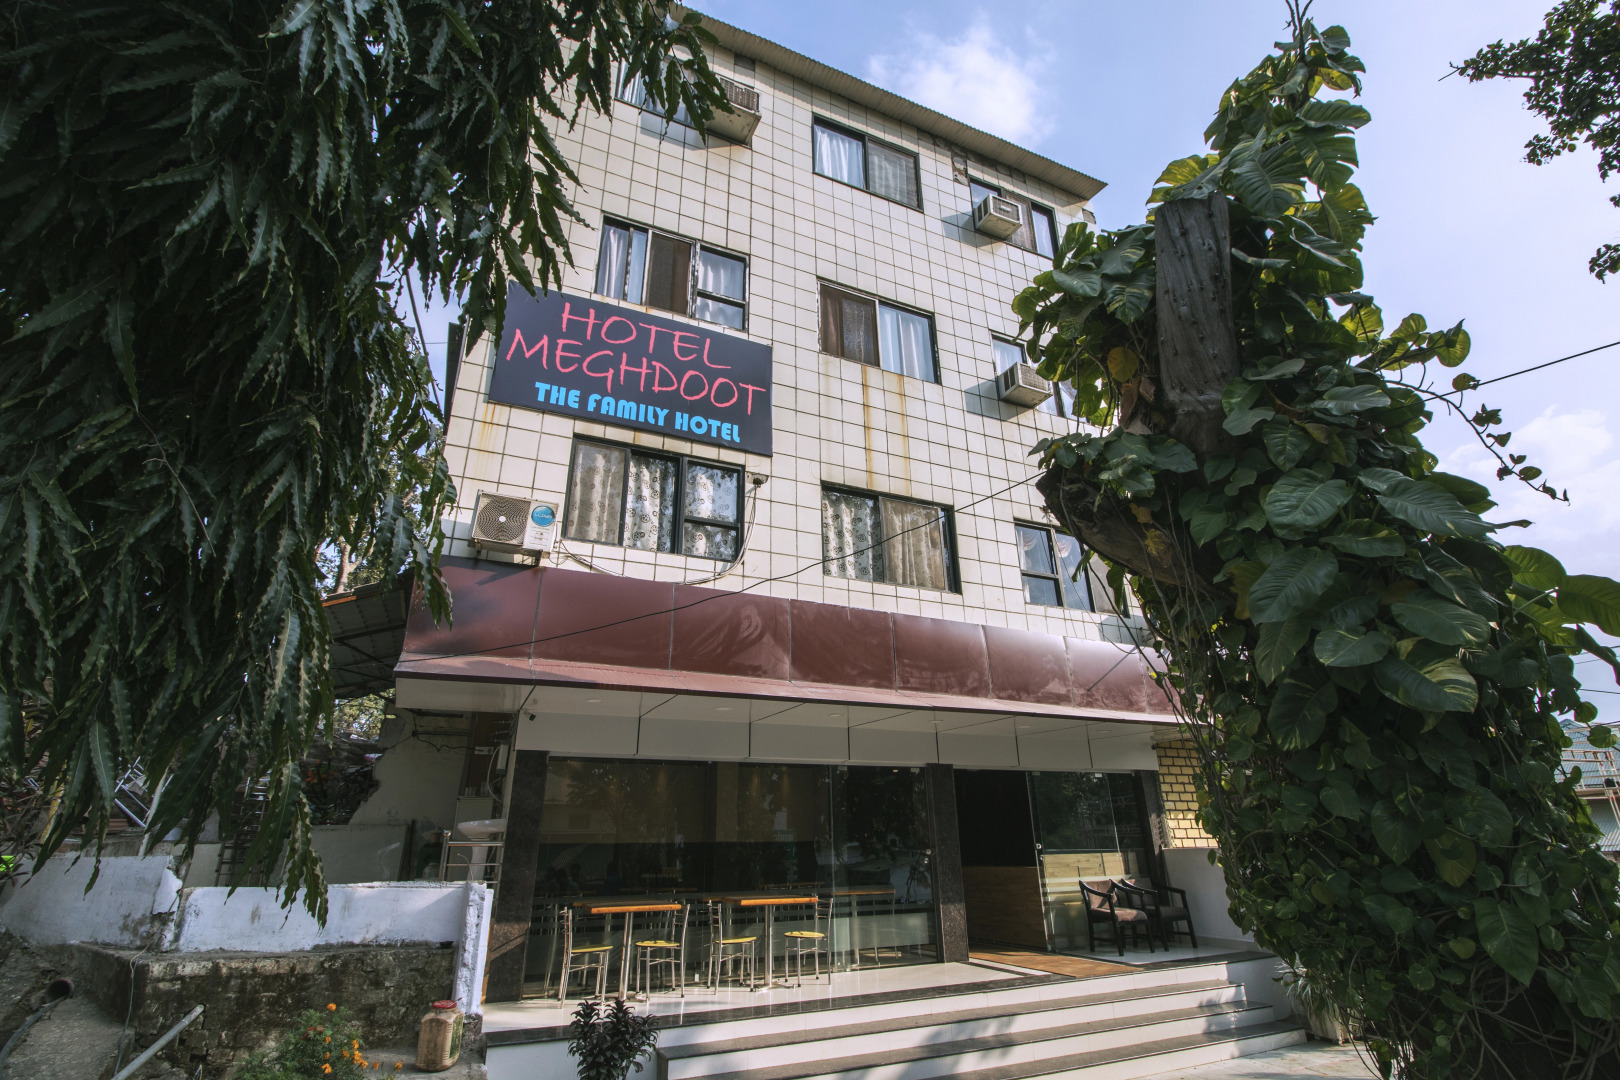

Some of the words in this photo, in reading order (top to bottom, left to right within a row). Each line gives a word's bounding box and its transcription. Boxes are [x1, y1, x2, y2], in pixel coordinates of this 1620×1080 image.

[561, 301, 732, 369] HOTEL
[505, 328, 767, 416] MEGHDOOT
[534, 381, 581, 409] THE
[587, 393, 670, 427] FAMILY
[675, 411, 742, 443] HOTEL
